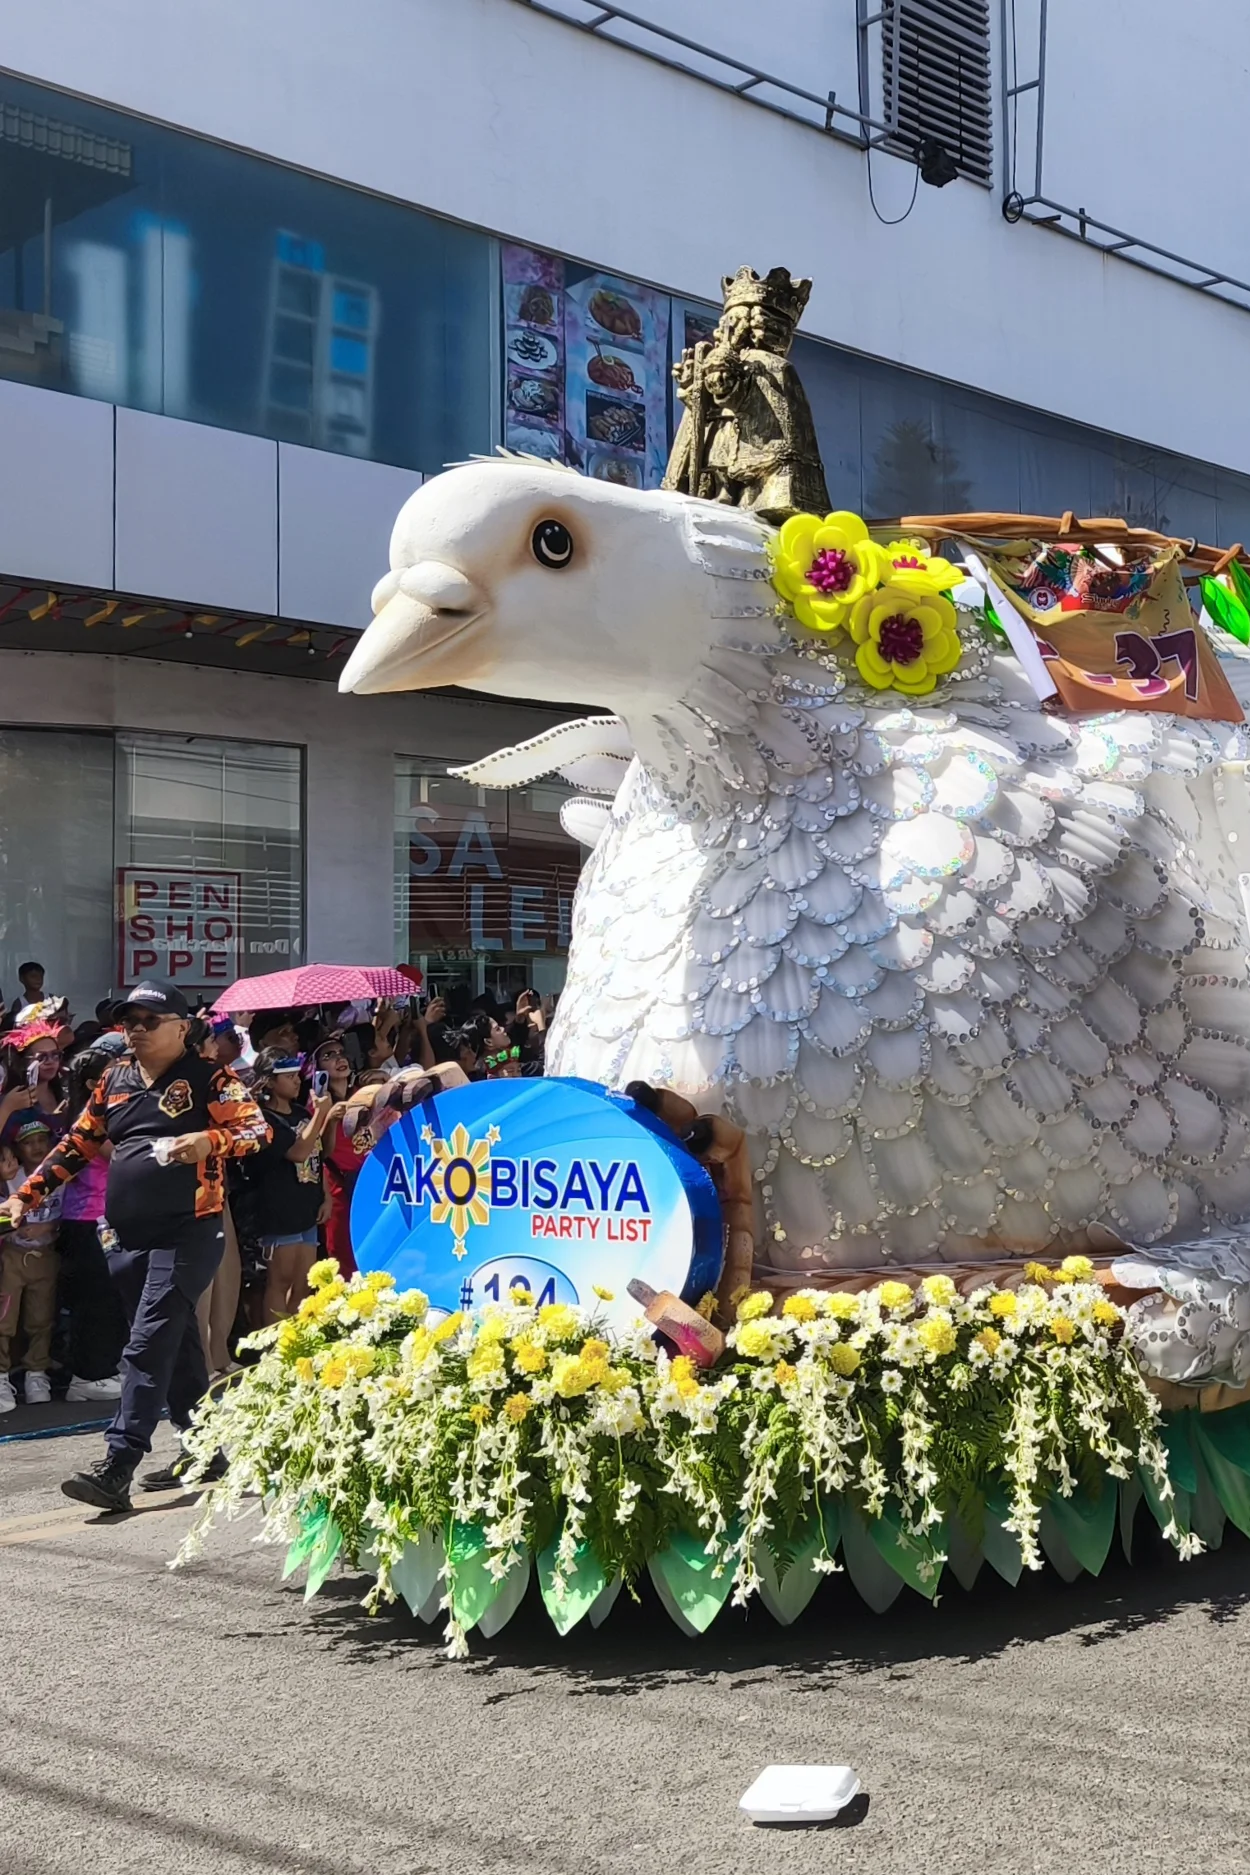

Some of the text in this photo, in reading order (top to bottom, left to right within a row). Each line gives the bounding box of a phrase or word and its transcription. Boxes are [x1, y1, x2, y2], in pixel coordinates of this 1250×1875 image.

[133, 880, 230, 909] PEN
[130, 915, 233, 942] SHO
[133, 950, 227, 977] PPE
[490, 1158, 651, 1213] BISAYA
[532, 1215, 651, 1242] PARTY LIST
